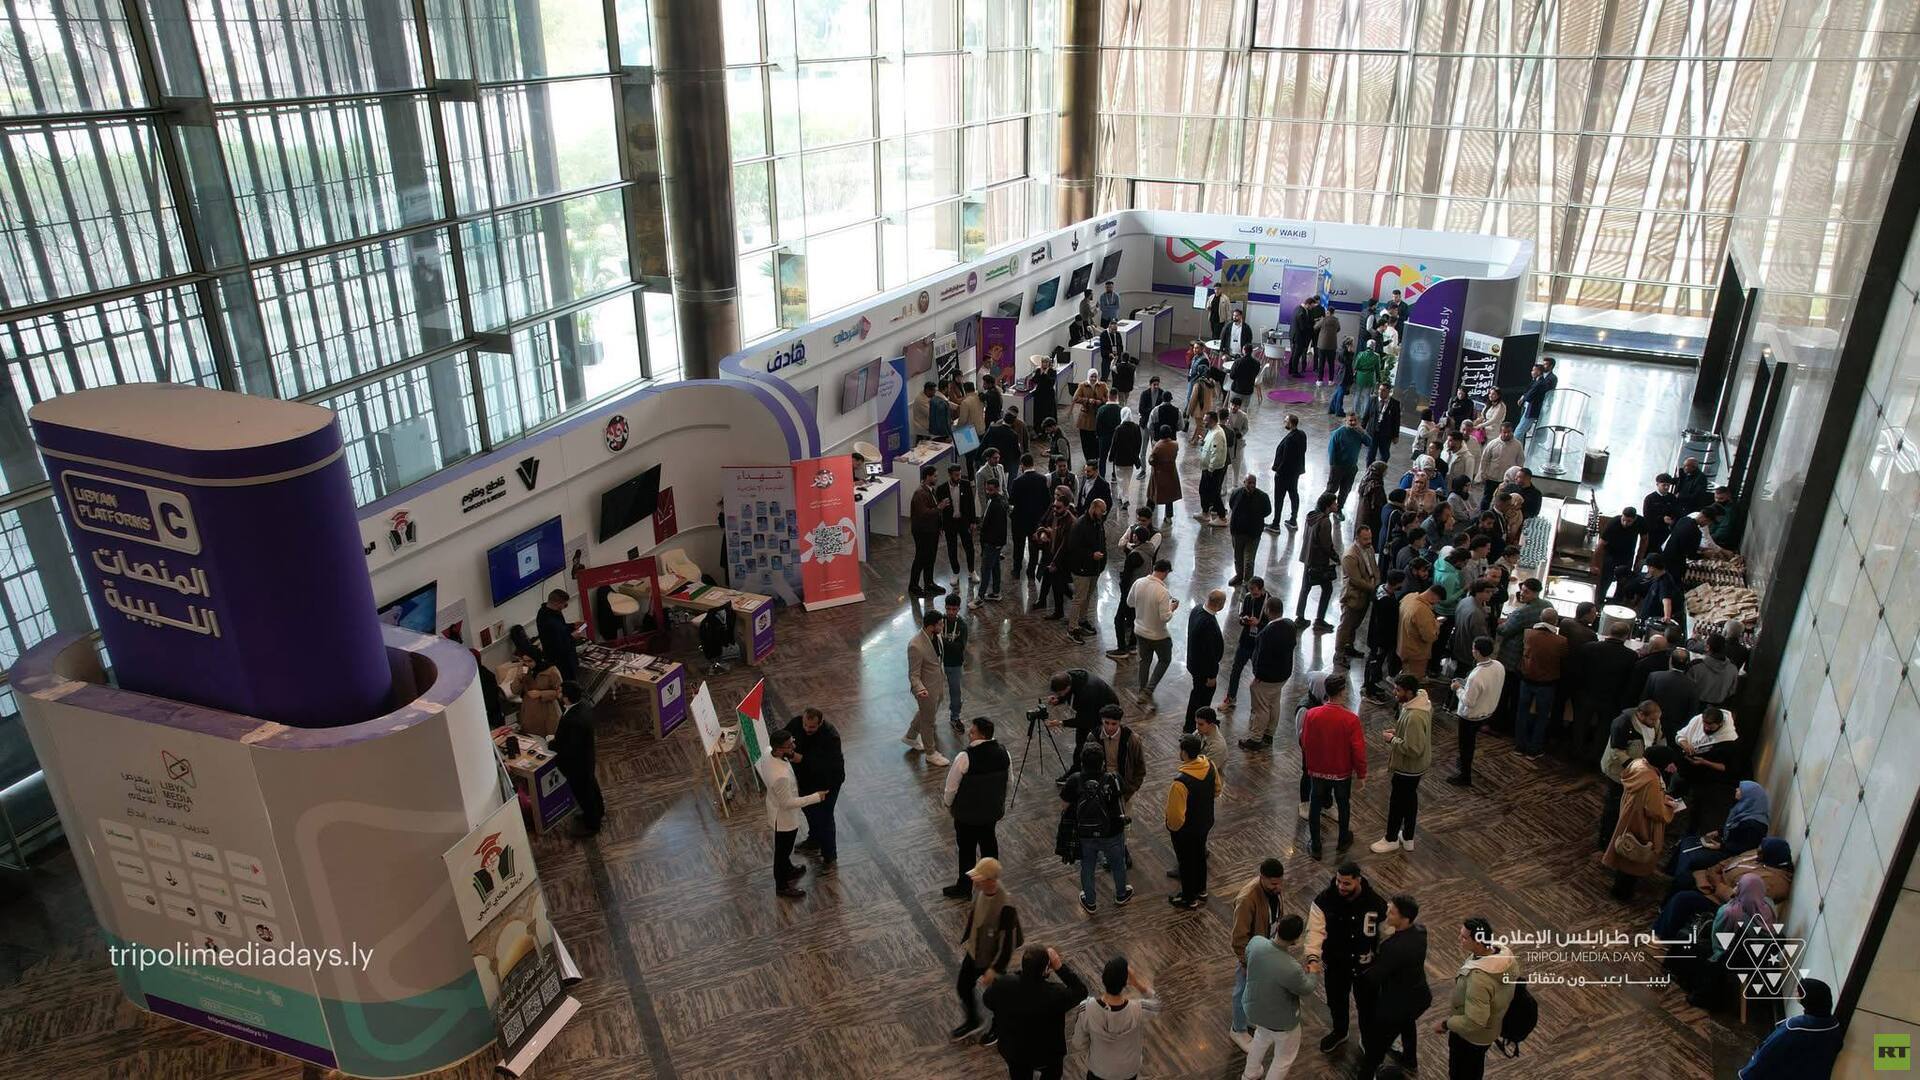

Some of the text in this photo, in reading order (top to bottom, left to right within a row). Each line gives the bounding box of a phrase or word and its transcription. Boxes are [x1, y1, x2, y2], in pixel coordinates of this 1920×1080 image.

[73, 487, 118, 507] LIBYAN
[79, 504, 152, 531] PLATFORMS
[92, 548, 210, 598] المنصات
